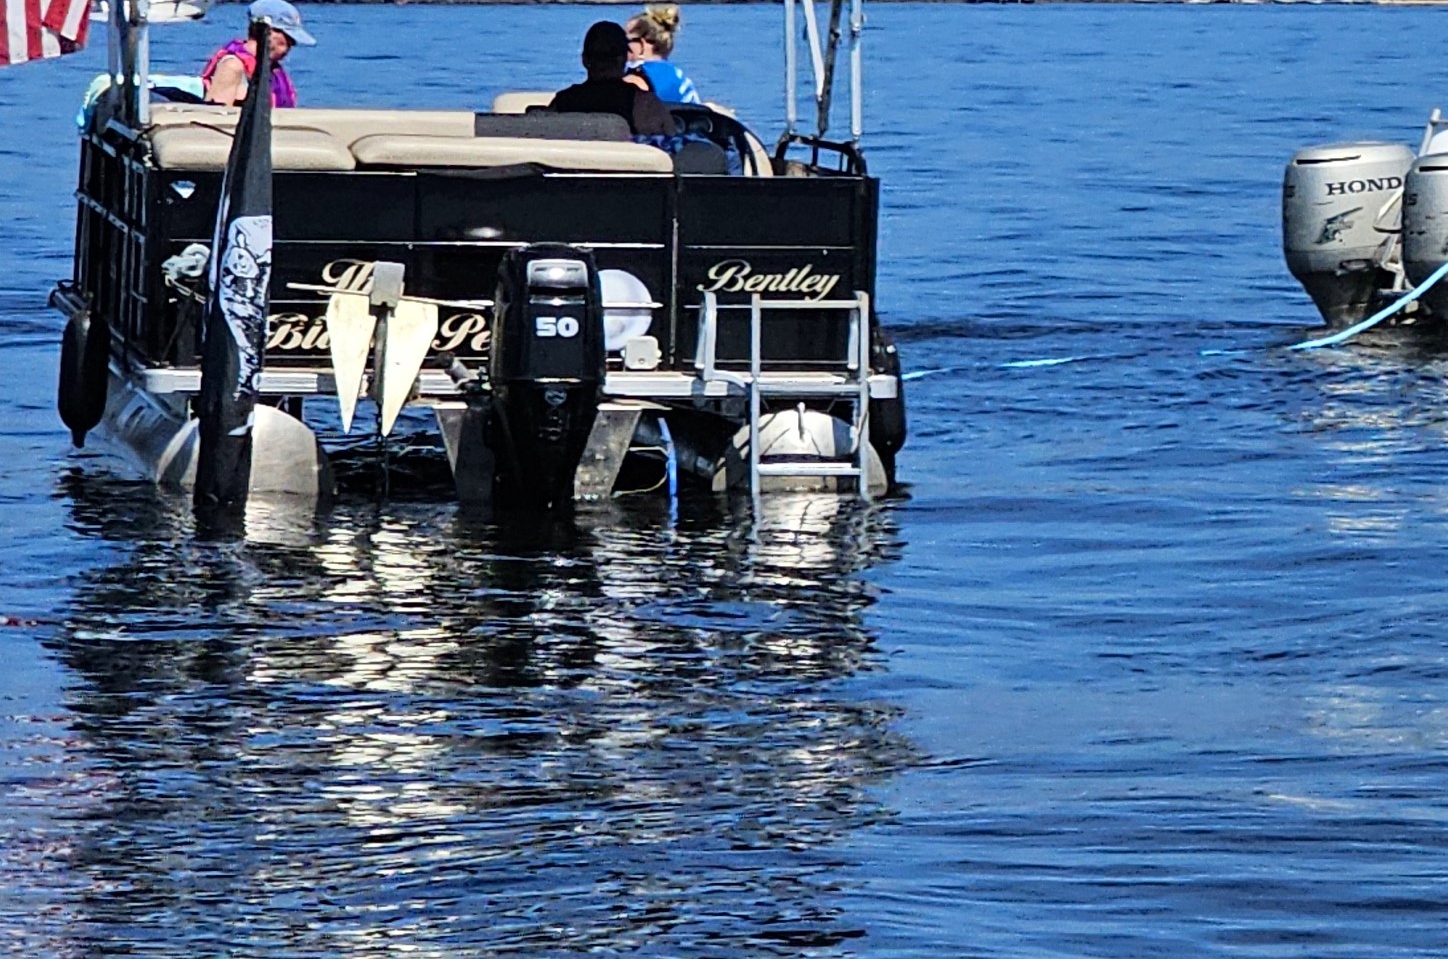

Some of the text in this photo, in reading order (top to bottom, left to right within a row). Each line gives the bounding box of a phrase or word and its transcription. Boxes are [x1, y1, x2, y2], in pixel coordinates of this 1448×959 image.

[1326, 176, 1402, 196] HOND
[317, 258, 404, 295] Th
[696, 259, 840, 301] Bentley
[536, 317, 579, 338] 50
